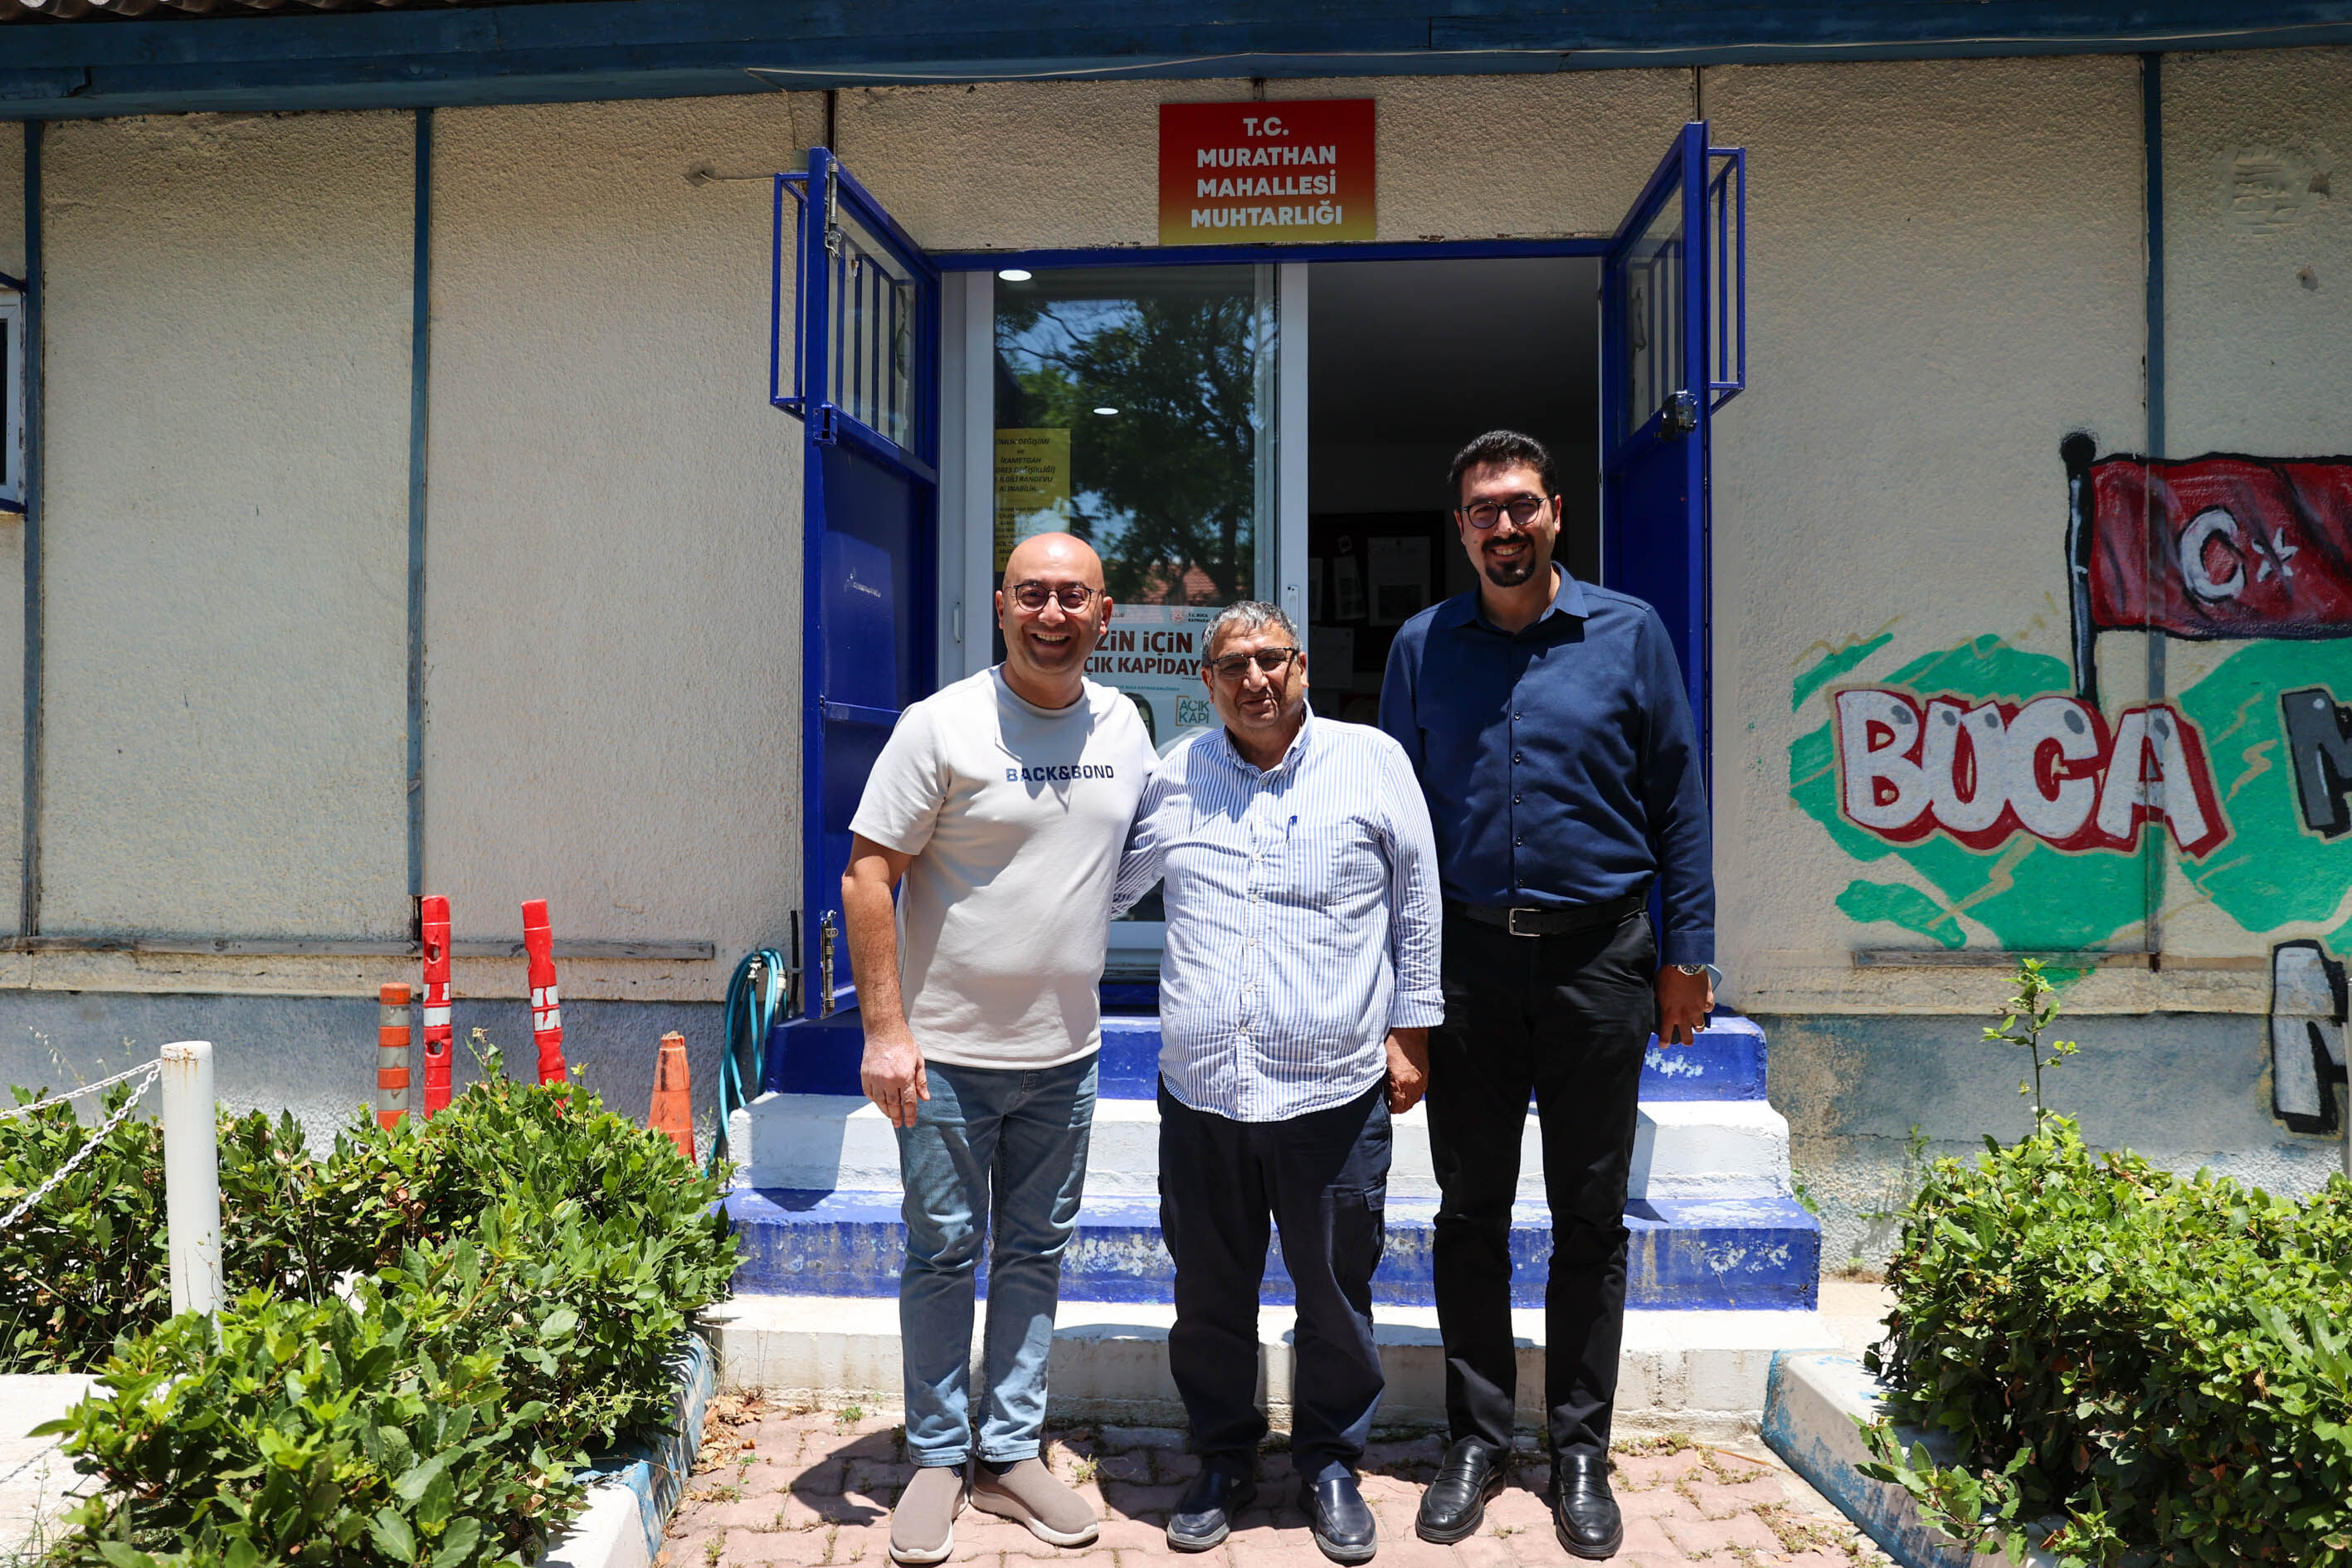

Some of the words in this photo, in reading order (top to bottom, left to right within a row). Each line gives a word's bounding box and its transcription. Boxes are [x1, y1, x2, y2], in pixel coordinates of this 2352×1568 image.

[1243, 116, 1289, 137] T.C.
[1197, 145, 1336, 168] MURATHAN
[1197, 169, 1336, 197] MAHALLESİ
[1191, 200, 1342, 228] MUHTARLIĞI
[1083, 656, 1113, 675] ÇIK
[1118, 657, 1201, 676] KAPIDAY
[1179, 712, 1210, 723] KAPI
[1006, 765, 1114, 782] BACK&BOND
[1835, 688, 2228, 858] BUCA
